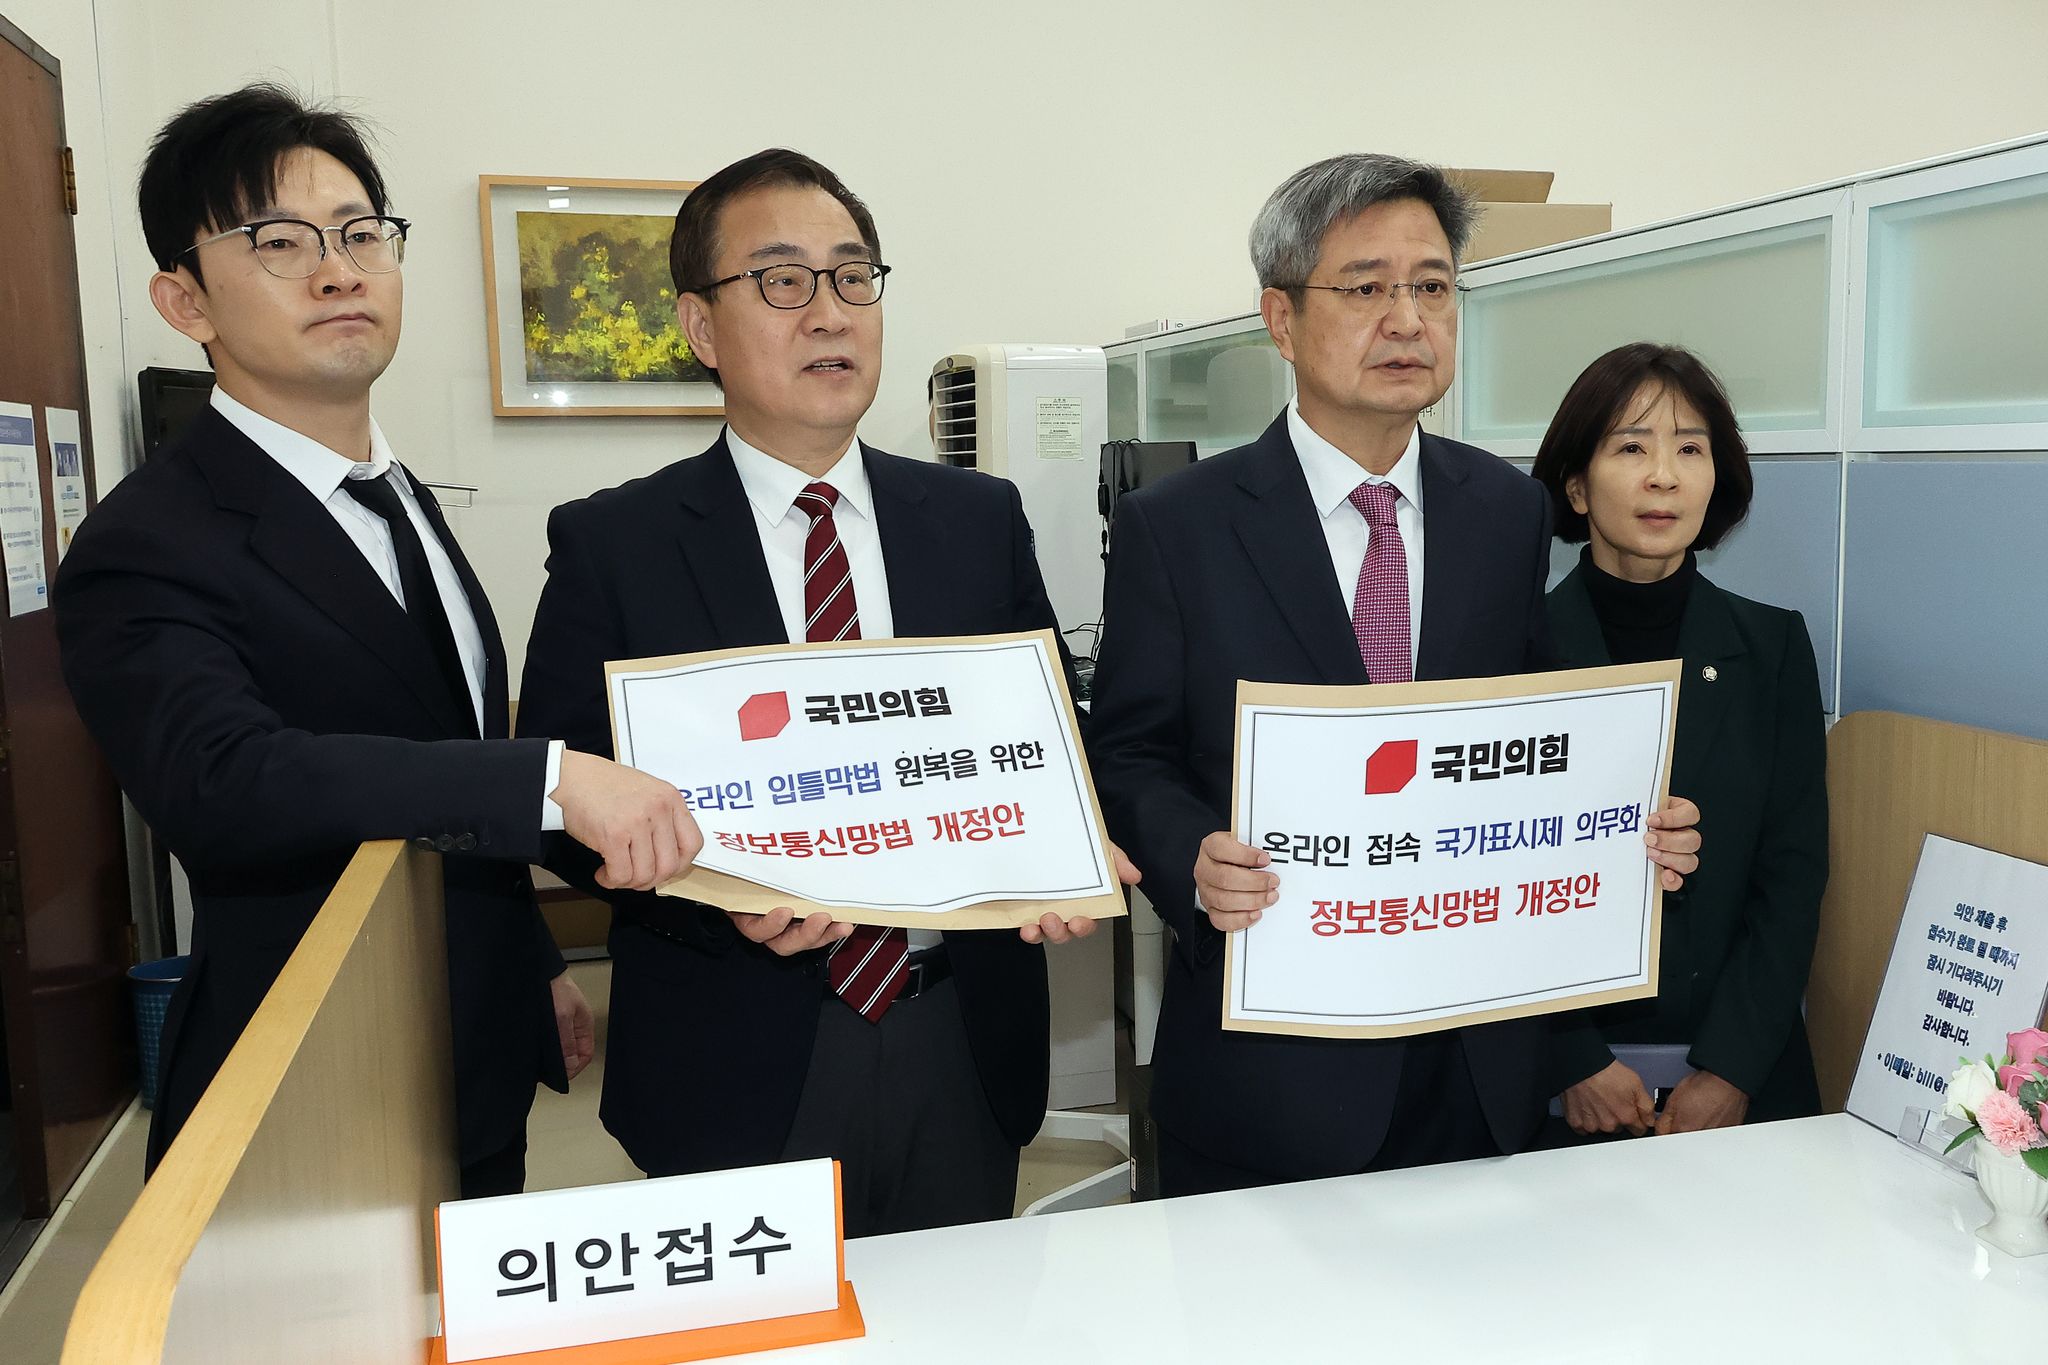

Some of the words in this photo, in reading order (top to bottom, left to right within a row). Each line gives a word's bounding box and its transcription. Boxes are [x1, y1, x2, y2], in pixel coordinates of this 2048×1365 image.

[804, 687, 952, 725] 국민의힘
[768, 761, 882, 805] 입틀막법
[895, 748, 978, 787] 원복을
[990, 741, 1044, 772] 위한
[1432, 733, 1569, 782] 국민의힘
[713, 819, 912, 857] 정보통신망법
[928, 802, 1025, 842] 개정안
[1262, 831, 1349, 866] 온라인
[1367, 832, 1421, 865] 접속
[1436, 817, 1562, 858] 국가표시제
[1574, 803, 1641, 842] 의무화
[1311, 887, 1500, 937] 정보통신망법
[1516, 873, 1600, 917] 개정안
[1954, 903, 1974, 922] 의안
[1996, 916, 2008, 933] 후
[1928, 924, 1956, 947] 접수가
[1946, 962, 2003, 996] 기다려주시기
[1922, 1015, 1970, 1046] 감사합니다.
[496, 1215, 792, 1302] 의안접수
